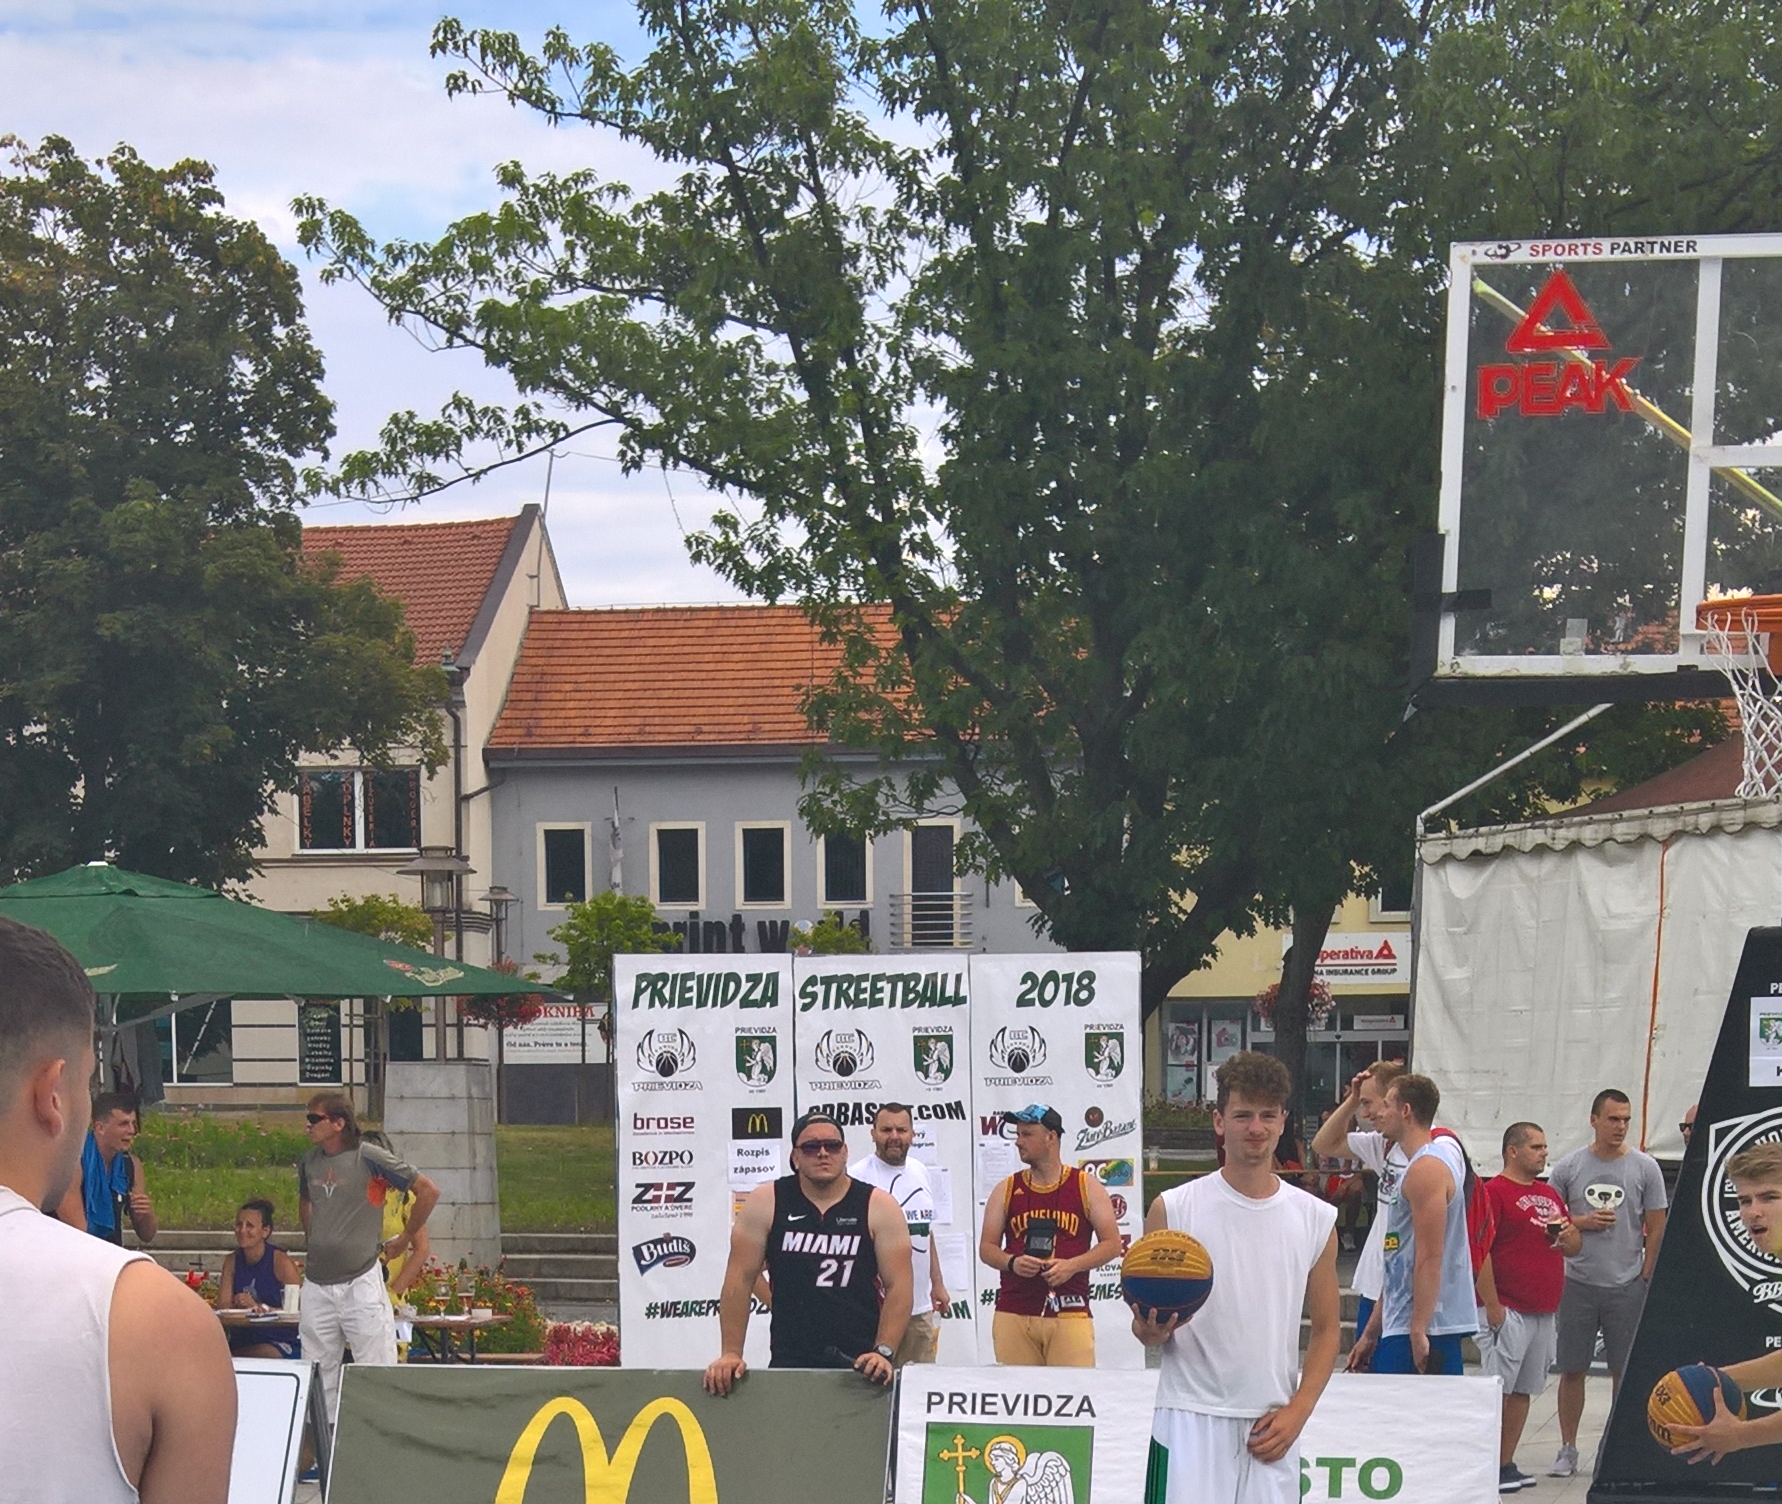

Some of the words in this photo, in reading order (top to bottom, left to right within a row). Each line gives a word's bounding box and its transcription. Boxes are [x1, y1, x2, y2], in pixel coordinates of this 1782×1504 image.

[1530, 242, 1603, 257] SPORTS
[1610, 240, 1698, 255] PARTNER
[1477, 356, 1643, 419] PEAK
[632, 971, 779, 1010] PRIEVIDZA
[799, 972, 967, 1012] STREETBALL
[1016, 970, 1096, 1008] 2018
[912, 1026, 953, 1034] PRIEVIDZA
[632, 1080, 703, 1092] PRIEVIDZA
[809, 1080, 882, 1091] PRIEVIDZA
[984, 1076, 1053, 1087] PRIEVIDZA
[633, 1112, 695, 1131] brose
[632, 1150, 694, 1166] BOZPO
[736, 1148, 770, 1158] Rozpis
[733, 1163, 775, 1175] zápasov
[782, 1231, 861, 1256] MIAMI
[816, 1259, 854, 1287] 21
[925, 1390, 1097, 1419] PRIEVIDZA
